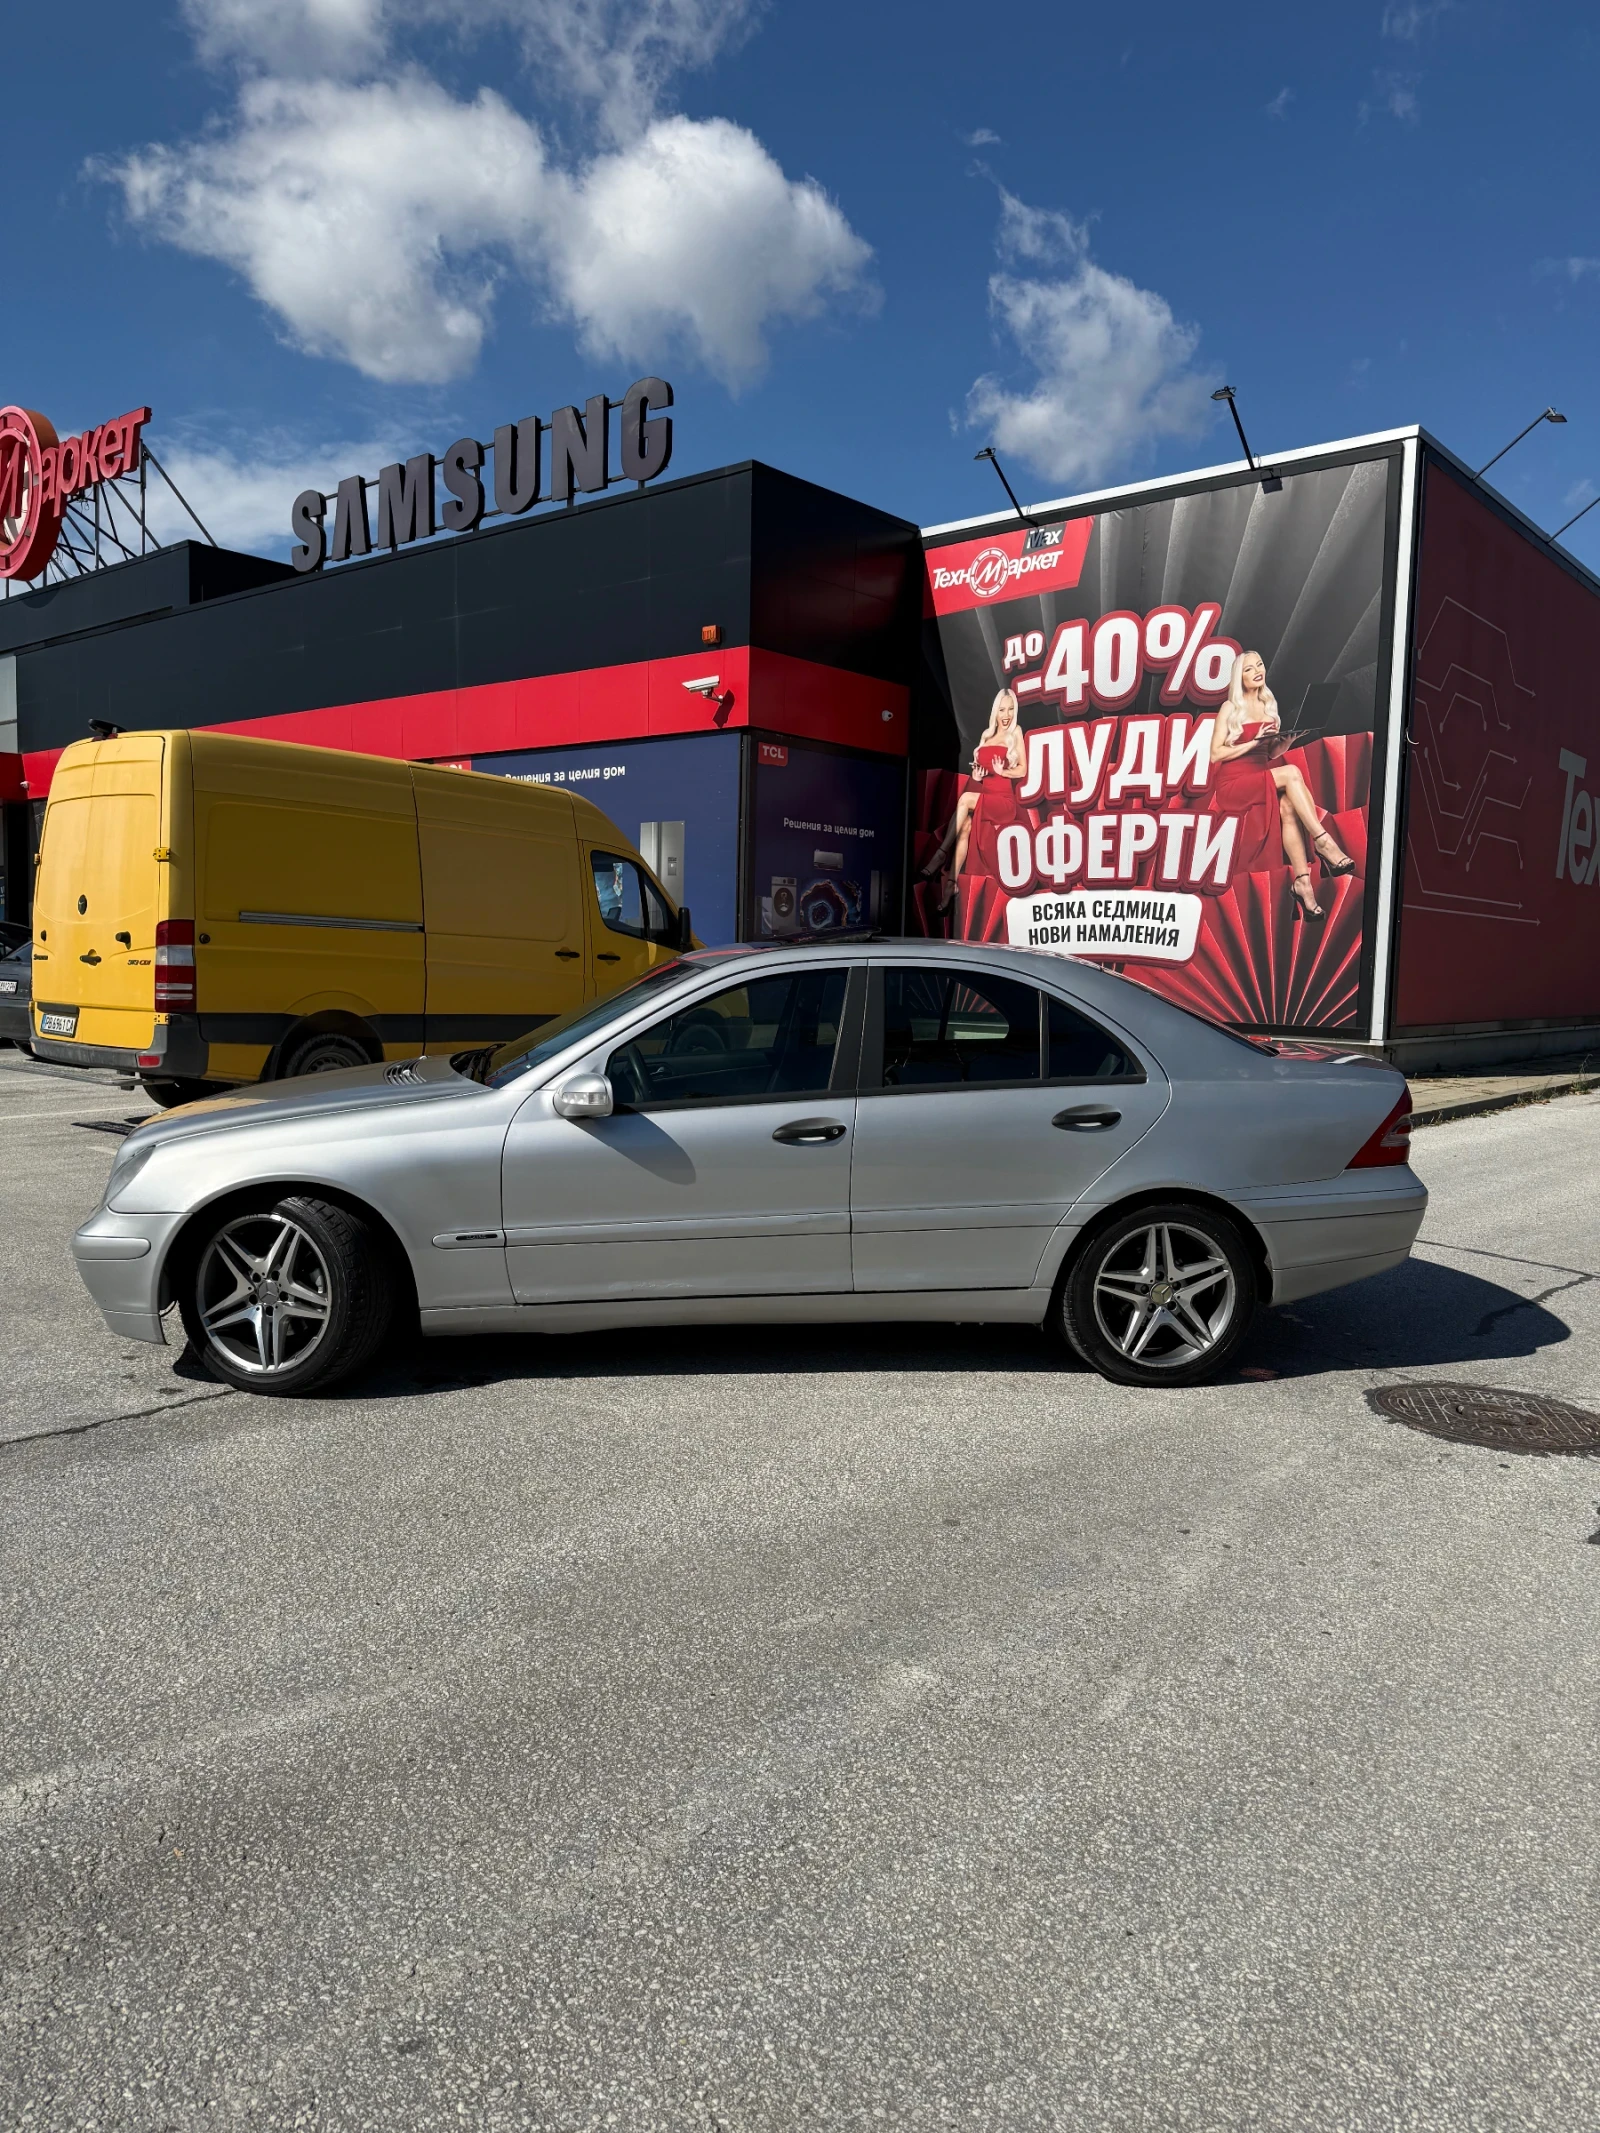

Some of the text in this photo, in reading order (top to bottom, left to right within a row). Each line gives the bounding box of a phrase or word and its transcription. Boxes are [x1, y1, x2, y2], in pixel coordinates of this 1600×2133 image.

[291, 376, 674, 573] SAMSUNG
[1026, 527, 1063, 549] Max
[1017, 609, 1236, 704] -40%
[762, 745, 785, 759] TCL
[1019, 718, 1216, 803] ЛУДИ
[553, 771, 565, 782] за
[568, 768, 600, 783] целия
[783, 817, 822, 831] Решения
[823, 823, 833, 833] за
[834, 825, 858, 836] целия
[997, 813, 1239, 888] ОФЕРТИ
[1032, 900, 1177, 924] ВСЯКА СЕДМИЦА
[1028, 924, 1180, 947] НОВИ НАМАЛЕНИЯ
